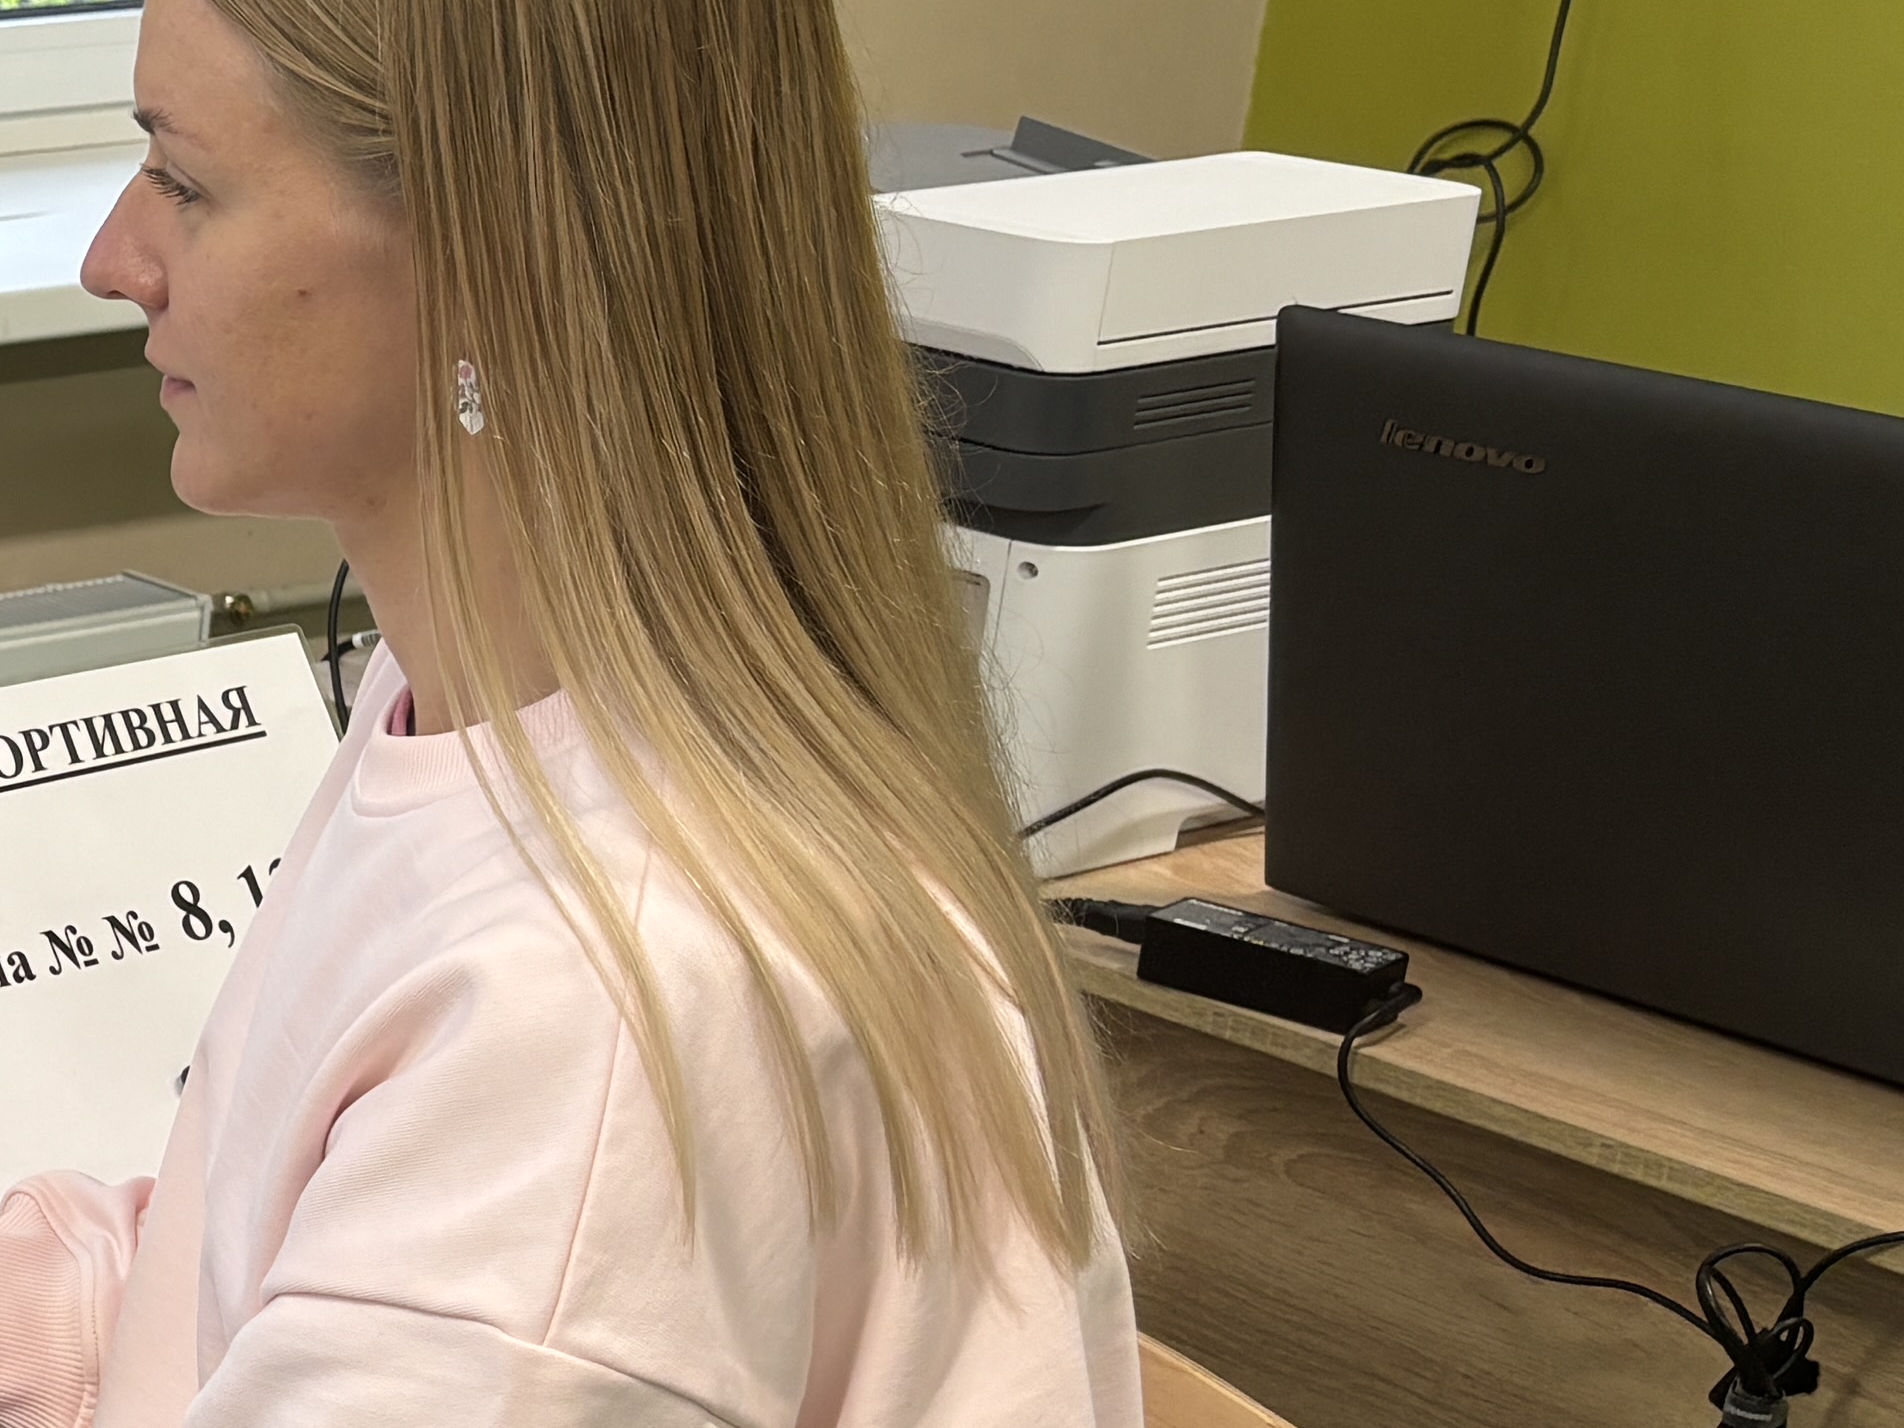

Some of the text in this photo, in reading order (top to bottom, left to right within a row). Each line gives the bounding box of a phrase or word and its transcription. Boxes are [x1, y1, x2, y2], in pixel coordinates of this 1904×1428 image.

[1380, 418, 1546, 474] lenovo
[40, 925, 99, 975] №
[103, 911, 160, 960] №
[171, 881, 236, 948] 8,
[237, 858, 282, 909] 1
